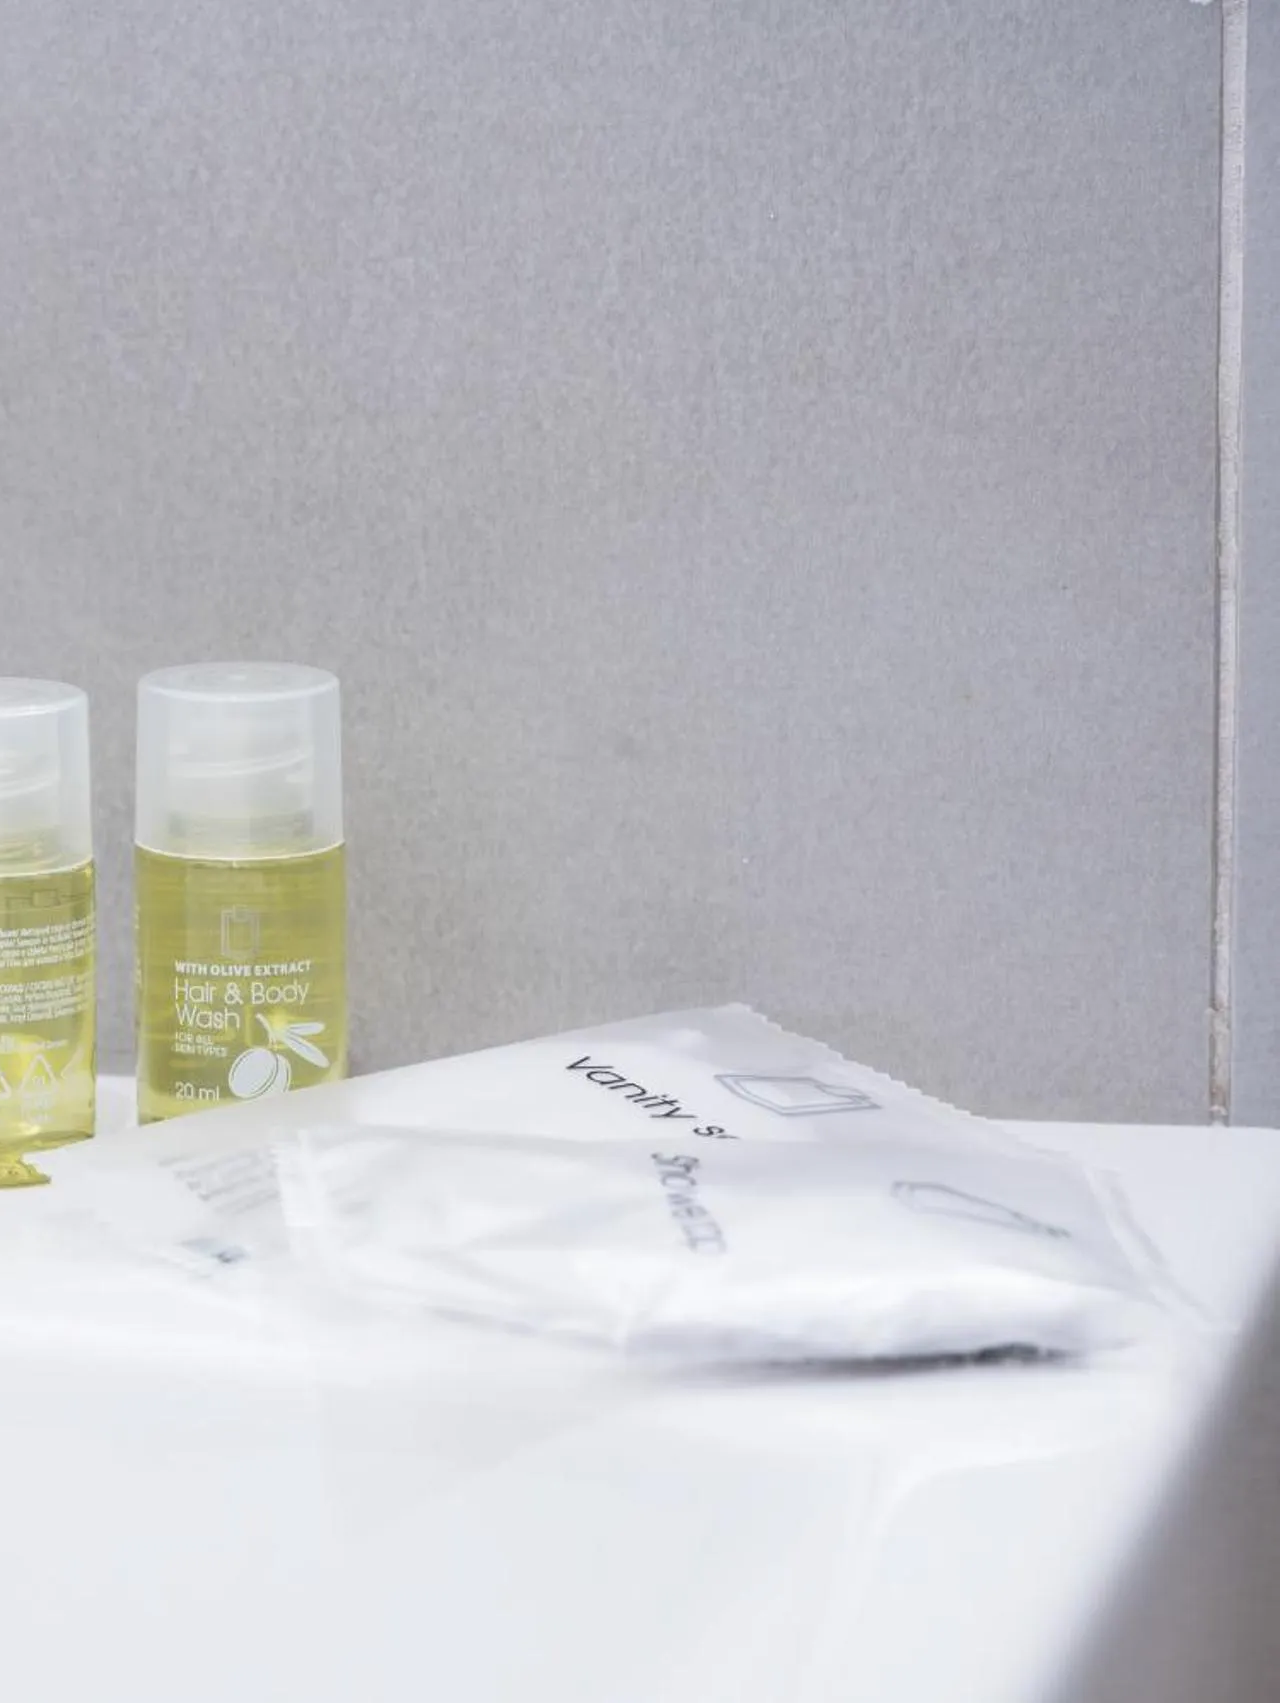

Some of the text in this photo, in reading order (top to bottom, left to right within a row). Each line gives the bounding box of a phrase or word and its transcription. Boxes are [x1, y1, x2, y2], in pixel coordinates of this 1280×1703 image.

[175, 960, 311, 976] WITH OLIVE EXTRACT
[175, 976, 310, 1005] Hair & Body
[175, 1003, 240, 1030] Wash
[175, 1081, 220, 1101] 20 ml
[565, 1055, 698, 1119] Vanity
